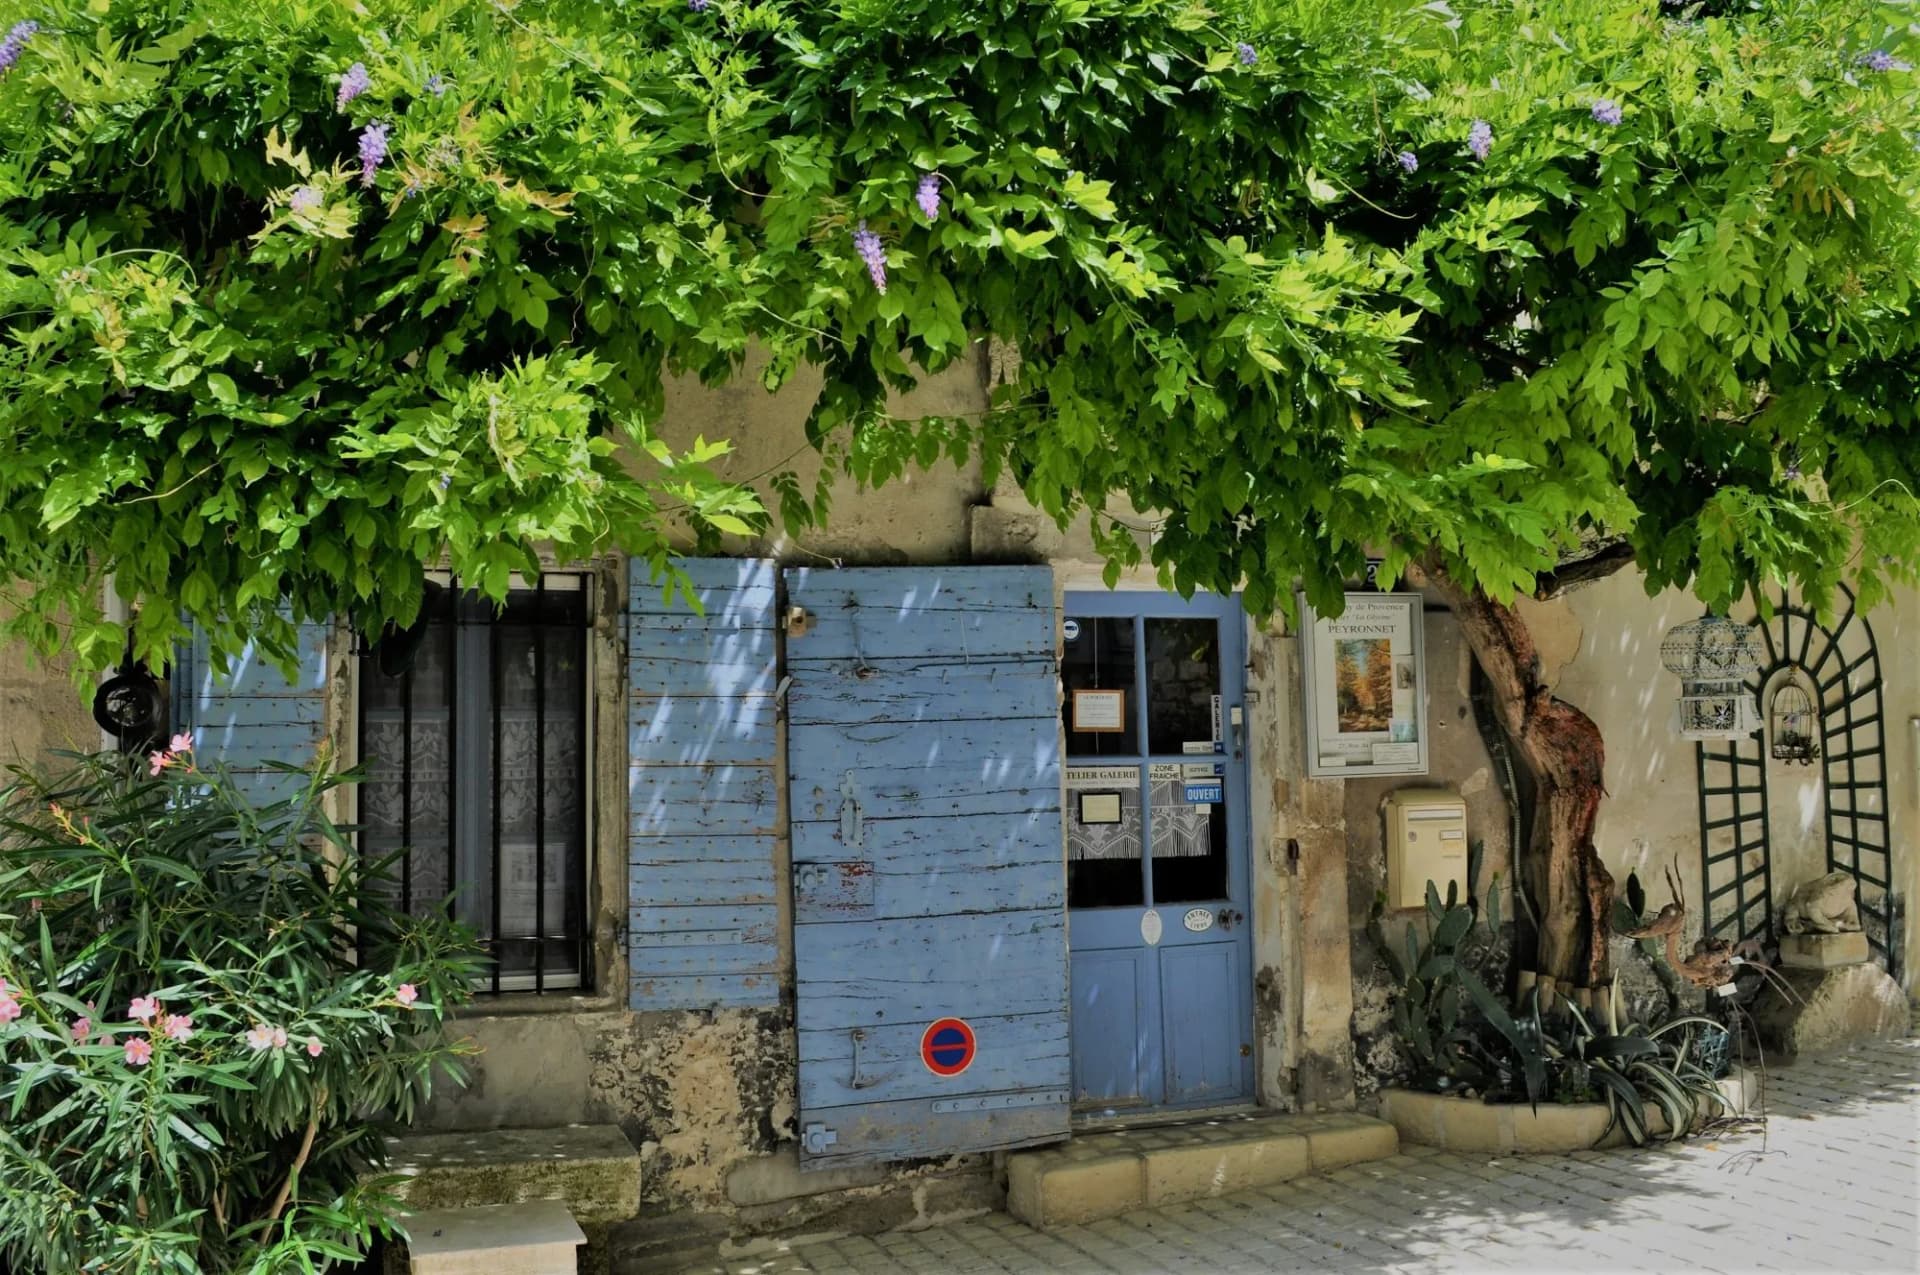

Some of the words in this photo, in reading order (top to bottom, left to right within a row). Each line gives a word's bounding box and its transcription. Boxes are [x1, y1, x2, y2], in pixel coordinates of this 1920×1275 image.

[1328, 625, 1396, 633] PEYRONNET
[1154, 764, 1174, 772] ZONE
[1066, 771, 1097, 780] TELIER
[1187, 788, 1220, 801] OUVERT
